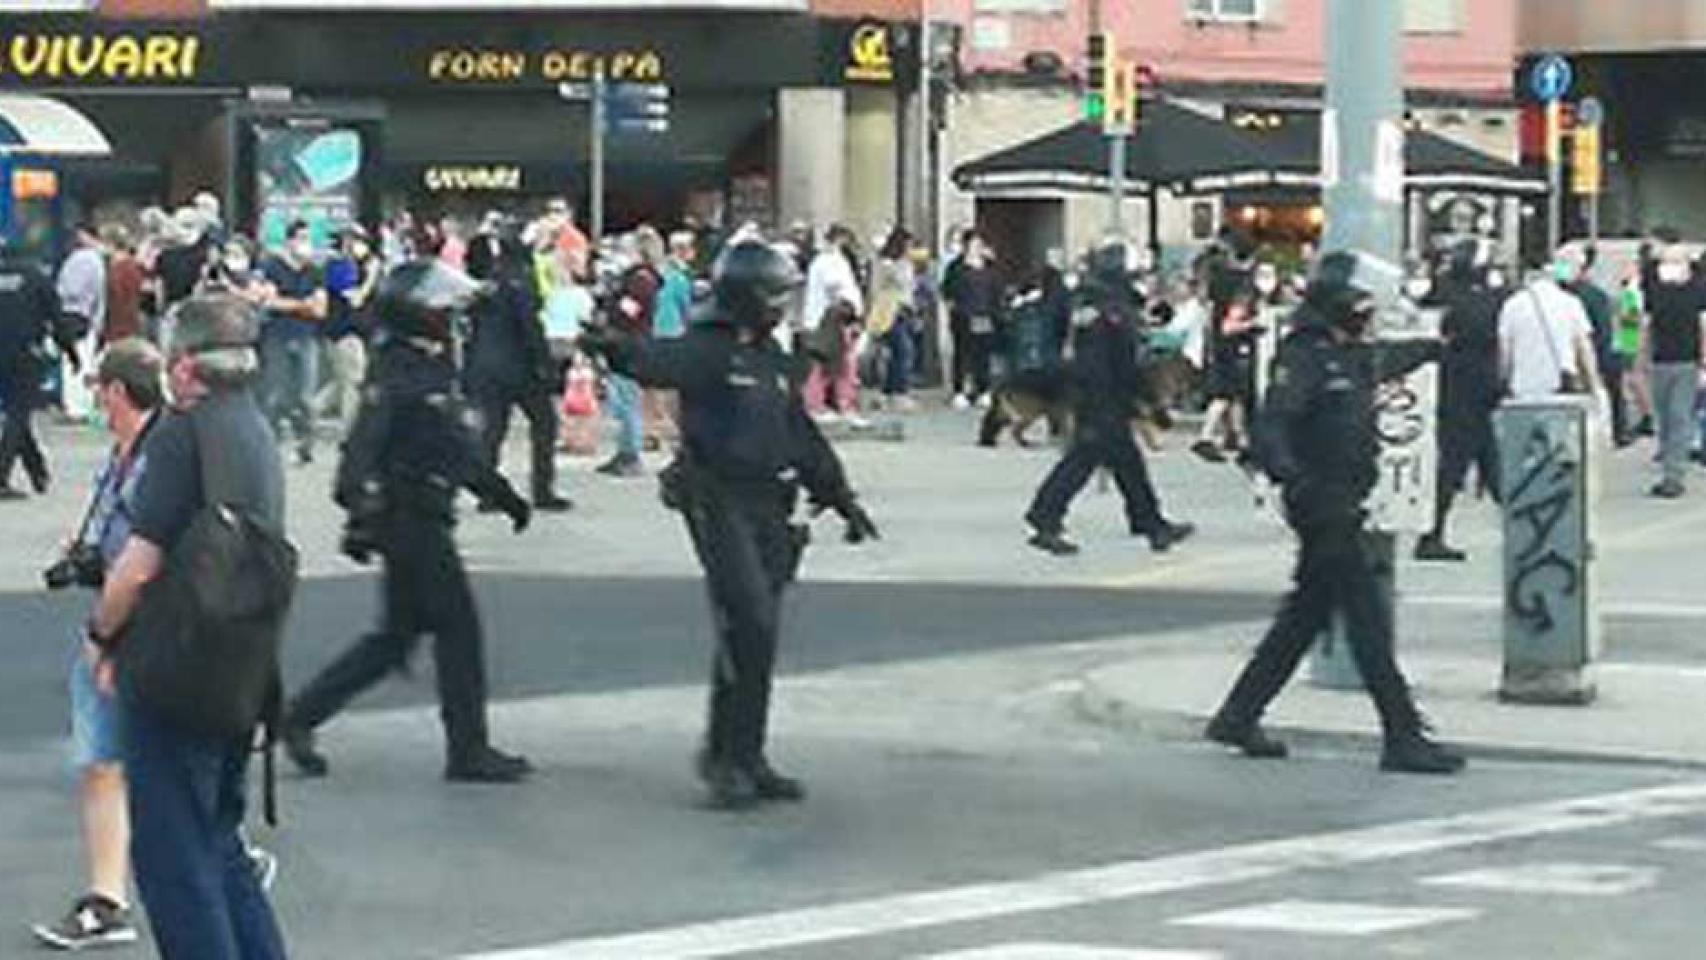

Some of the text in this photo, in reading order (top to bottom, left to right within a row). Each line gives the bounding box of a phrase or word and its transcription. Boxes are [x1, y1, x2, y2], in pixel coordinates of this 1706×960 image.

[10, 34, 199, 77] VIVARI
[428, 50, 525, 79] FORN
[542, 50, 589, 79] DE
